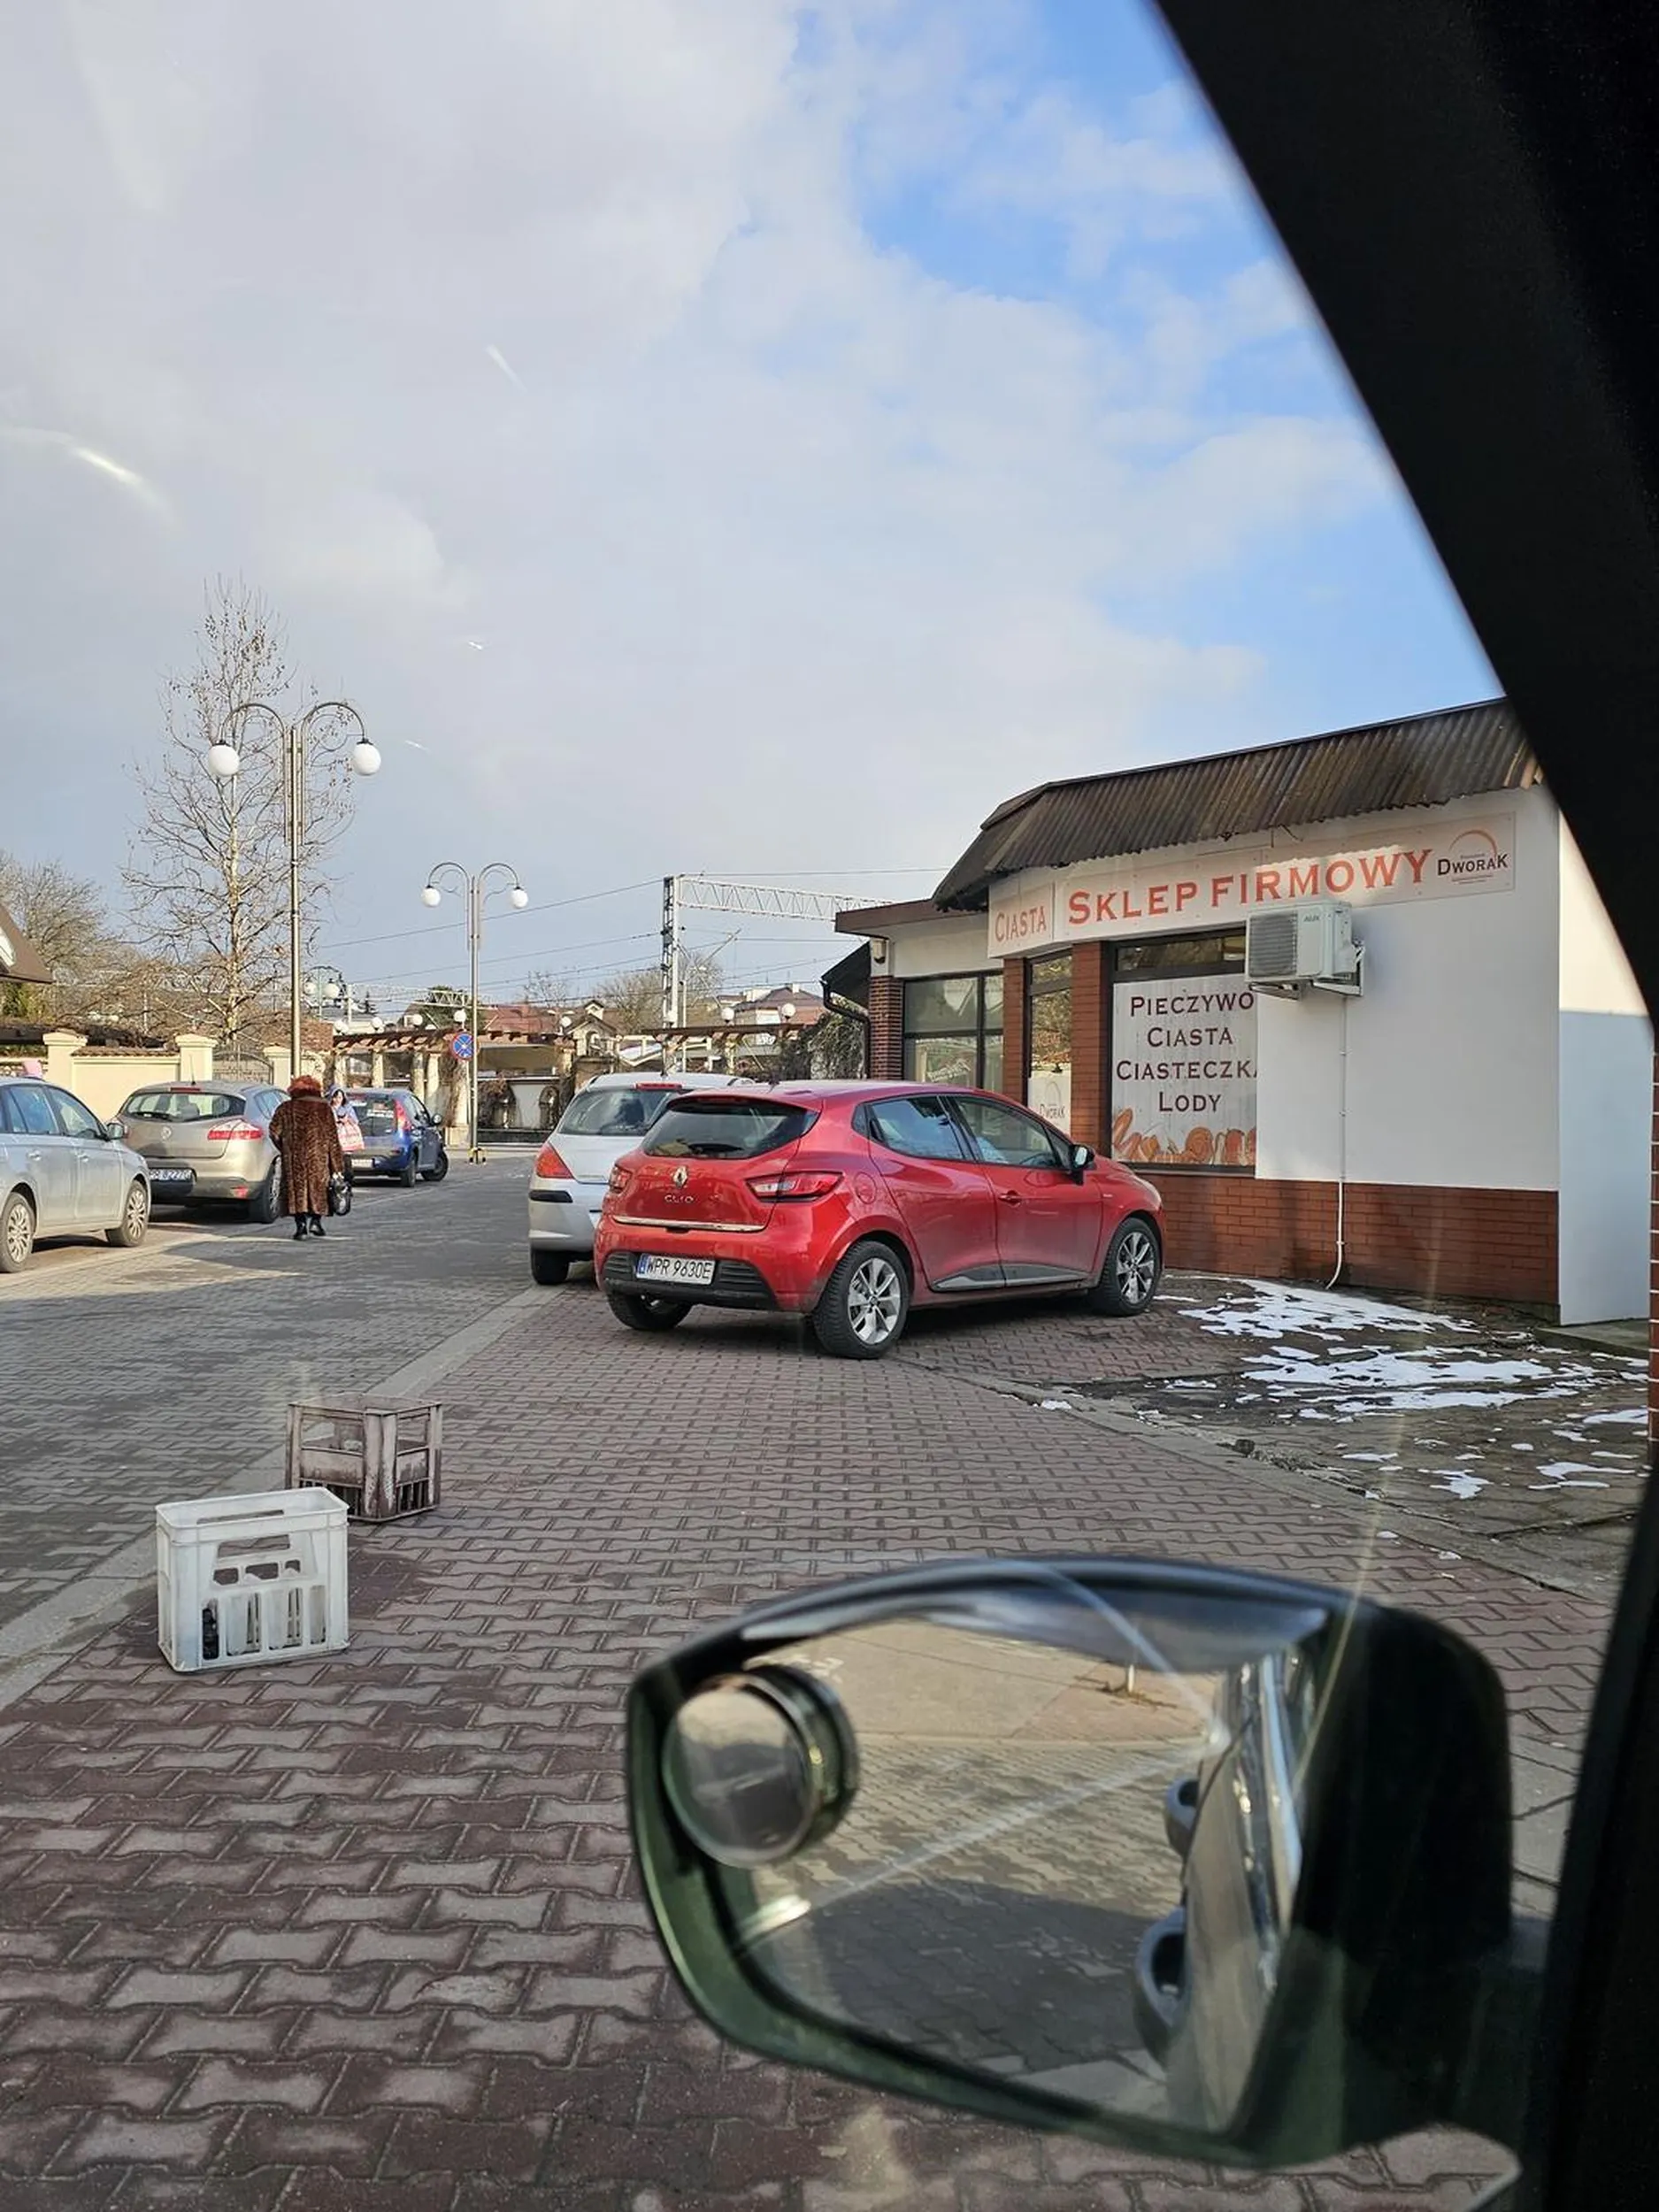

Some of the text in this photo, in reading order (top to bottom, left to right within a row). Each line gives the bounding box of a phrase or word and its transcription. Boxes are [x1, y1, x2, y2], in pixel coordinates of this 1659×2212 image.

[1437, 853, 1509, 877] DWORAK
[1068, 849, 1433, 926] SKLEP FIRMOWY
[995, 905, 1048, 942] CIASTA
[1130, 992, 1255, 1018] PIECZYWO
[1147, 1026, 1233, 1048] CIASTA
[1116, 1060, 1257, 1081] CIASTECZK
[1158, 1091, 1222, 1113] LODY
[646, 1257, 713, 1279] WPR 9630E
